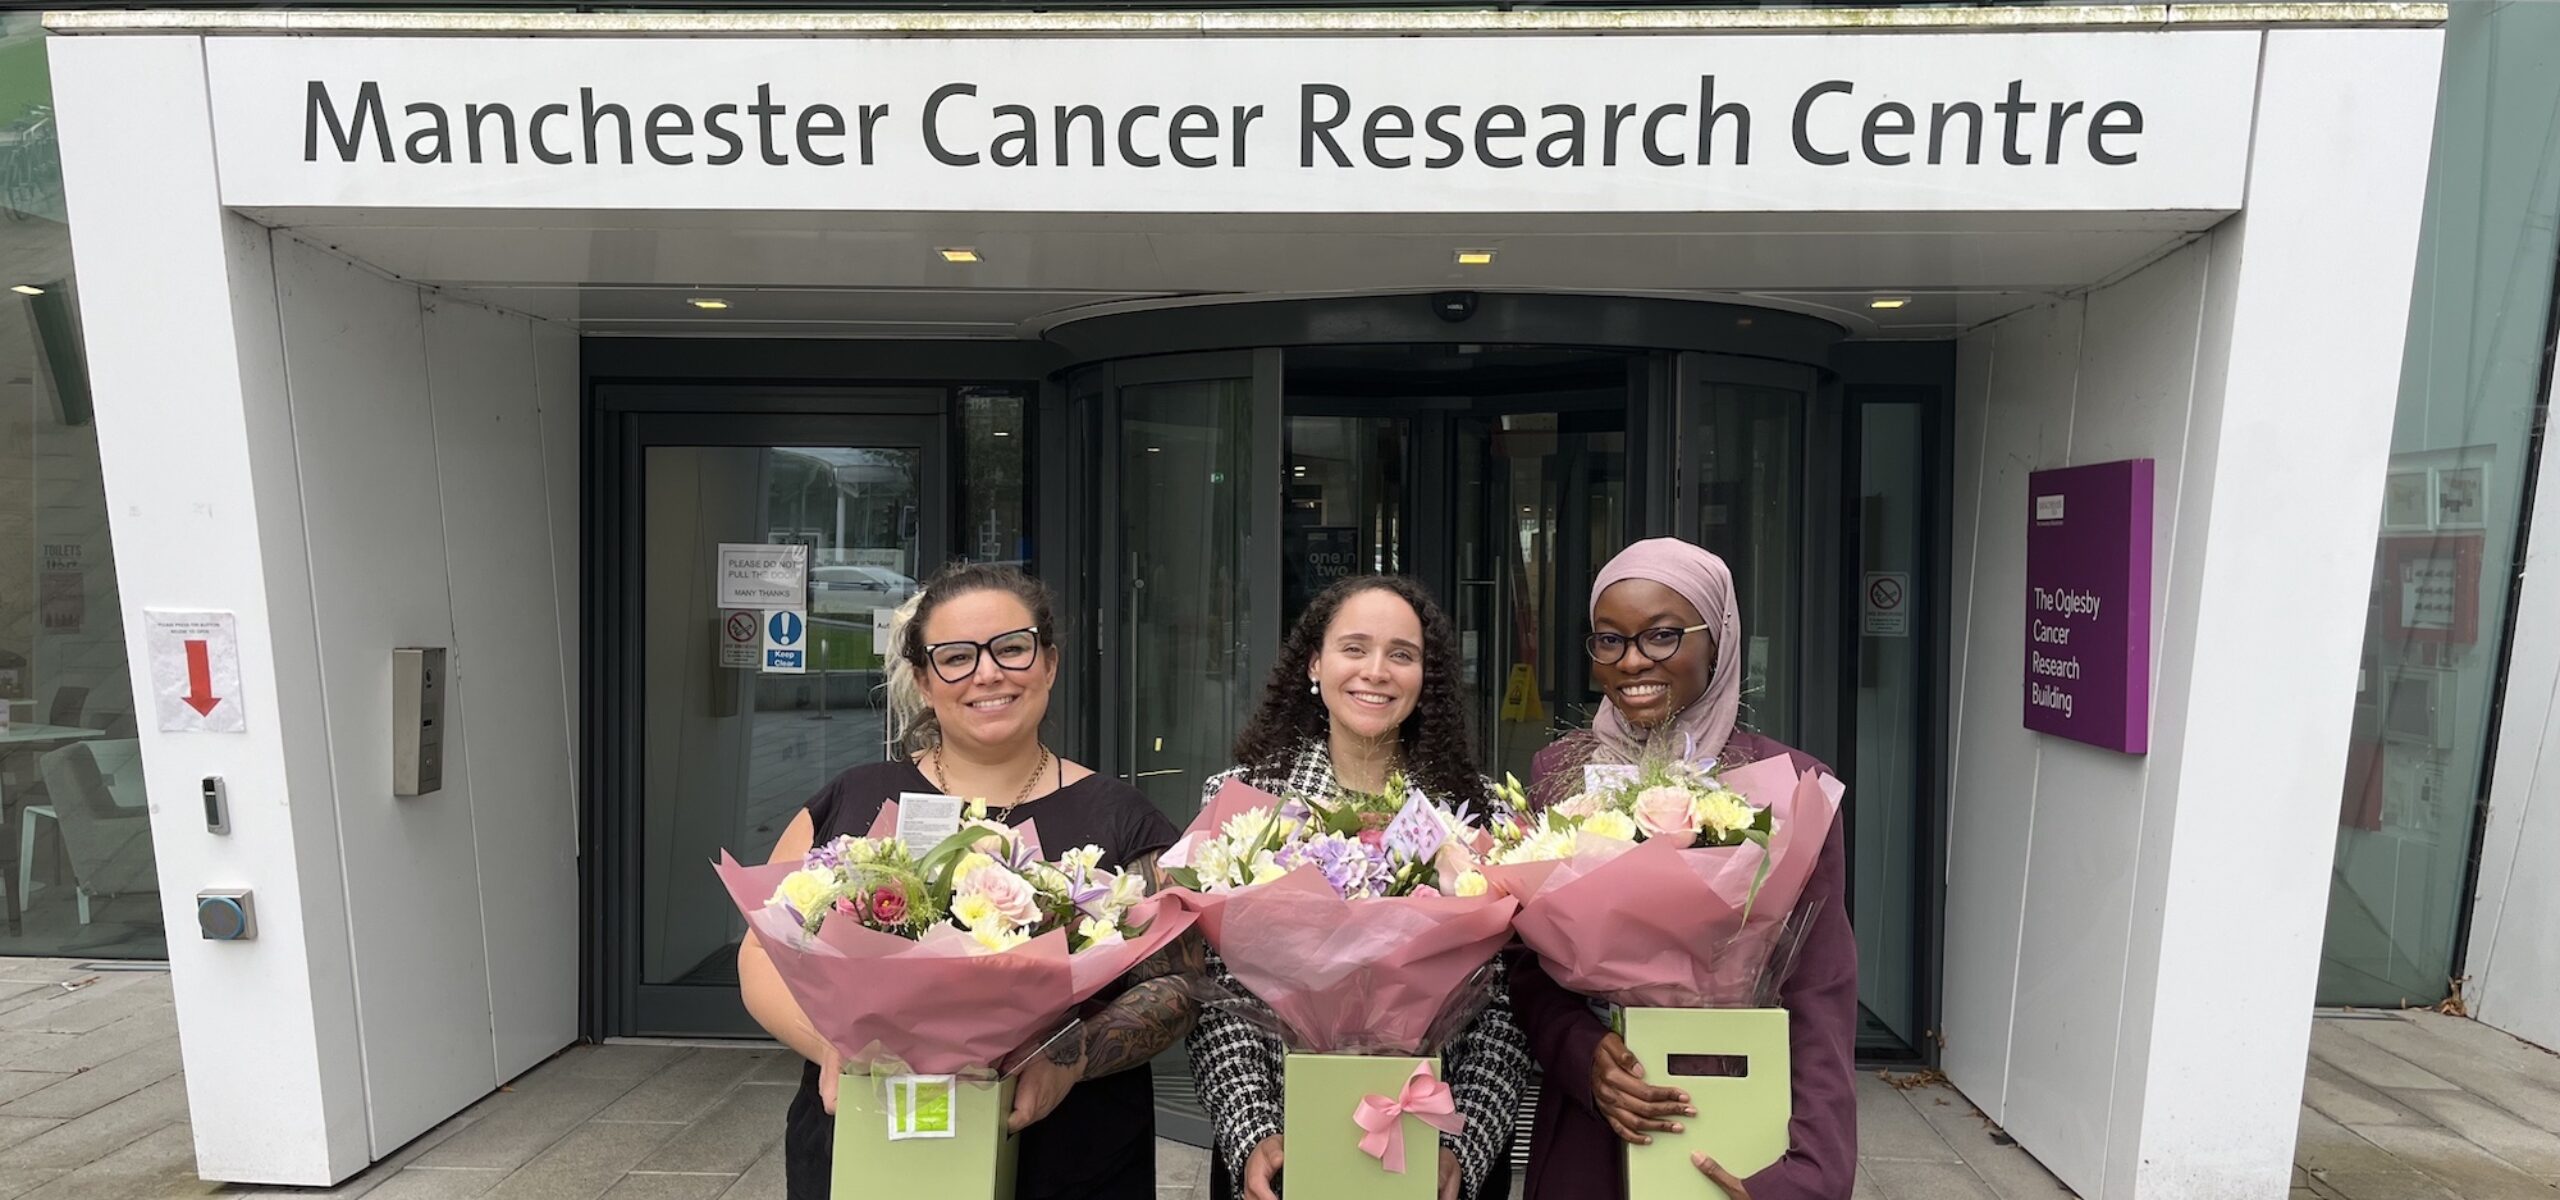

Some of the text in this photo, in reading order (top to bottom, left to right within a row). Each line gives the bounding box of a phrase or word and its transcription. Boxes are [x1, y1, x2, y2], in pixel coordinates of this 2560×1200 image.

[304, 74, 2144, 168] Manchester Cancer Research Centre
[43, 544, 82, 556] TOILETS
[728, 560, 798, 569] PLEASE DO NOT
[1309, 552, 1341, 564] one
[728, 570, 749, 579] PULL
[751, 570, 768, 579] THE
[1316, 563, 1348, 577] two
[735, 589, 791, 598] MANY THANKS
[2034, 587, 2100, 621] The Oglesby
[2033, 619, 2070, 645] Cancer
[774, 651, 795, 659] Keep
[2032, 650, 2080, 680] Research
[2032, 682, 2072, 718] Building
